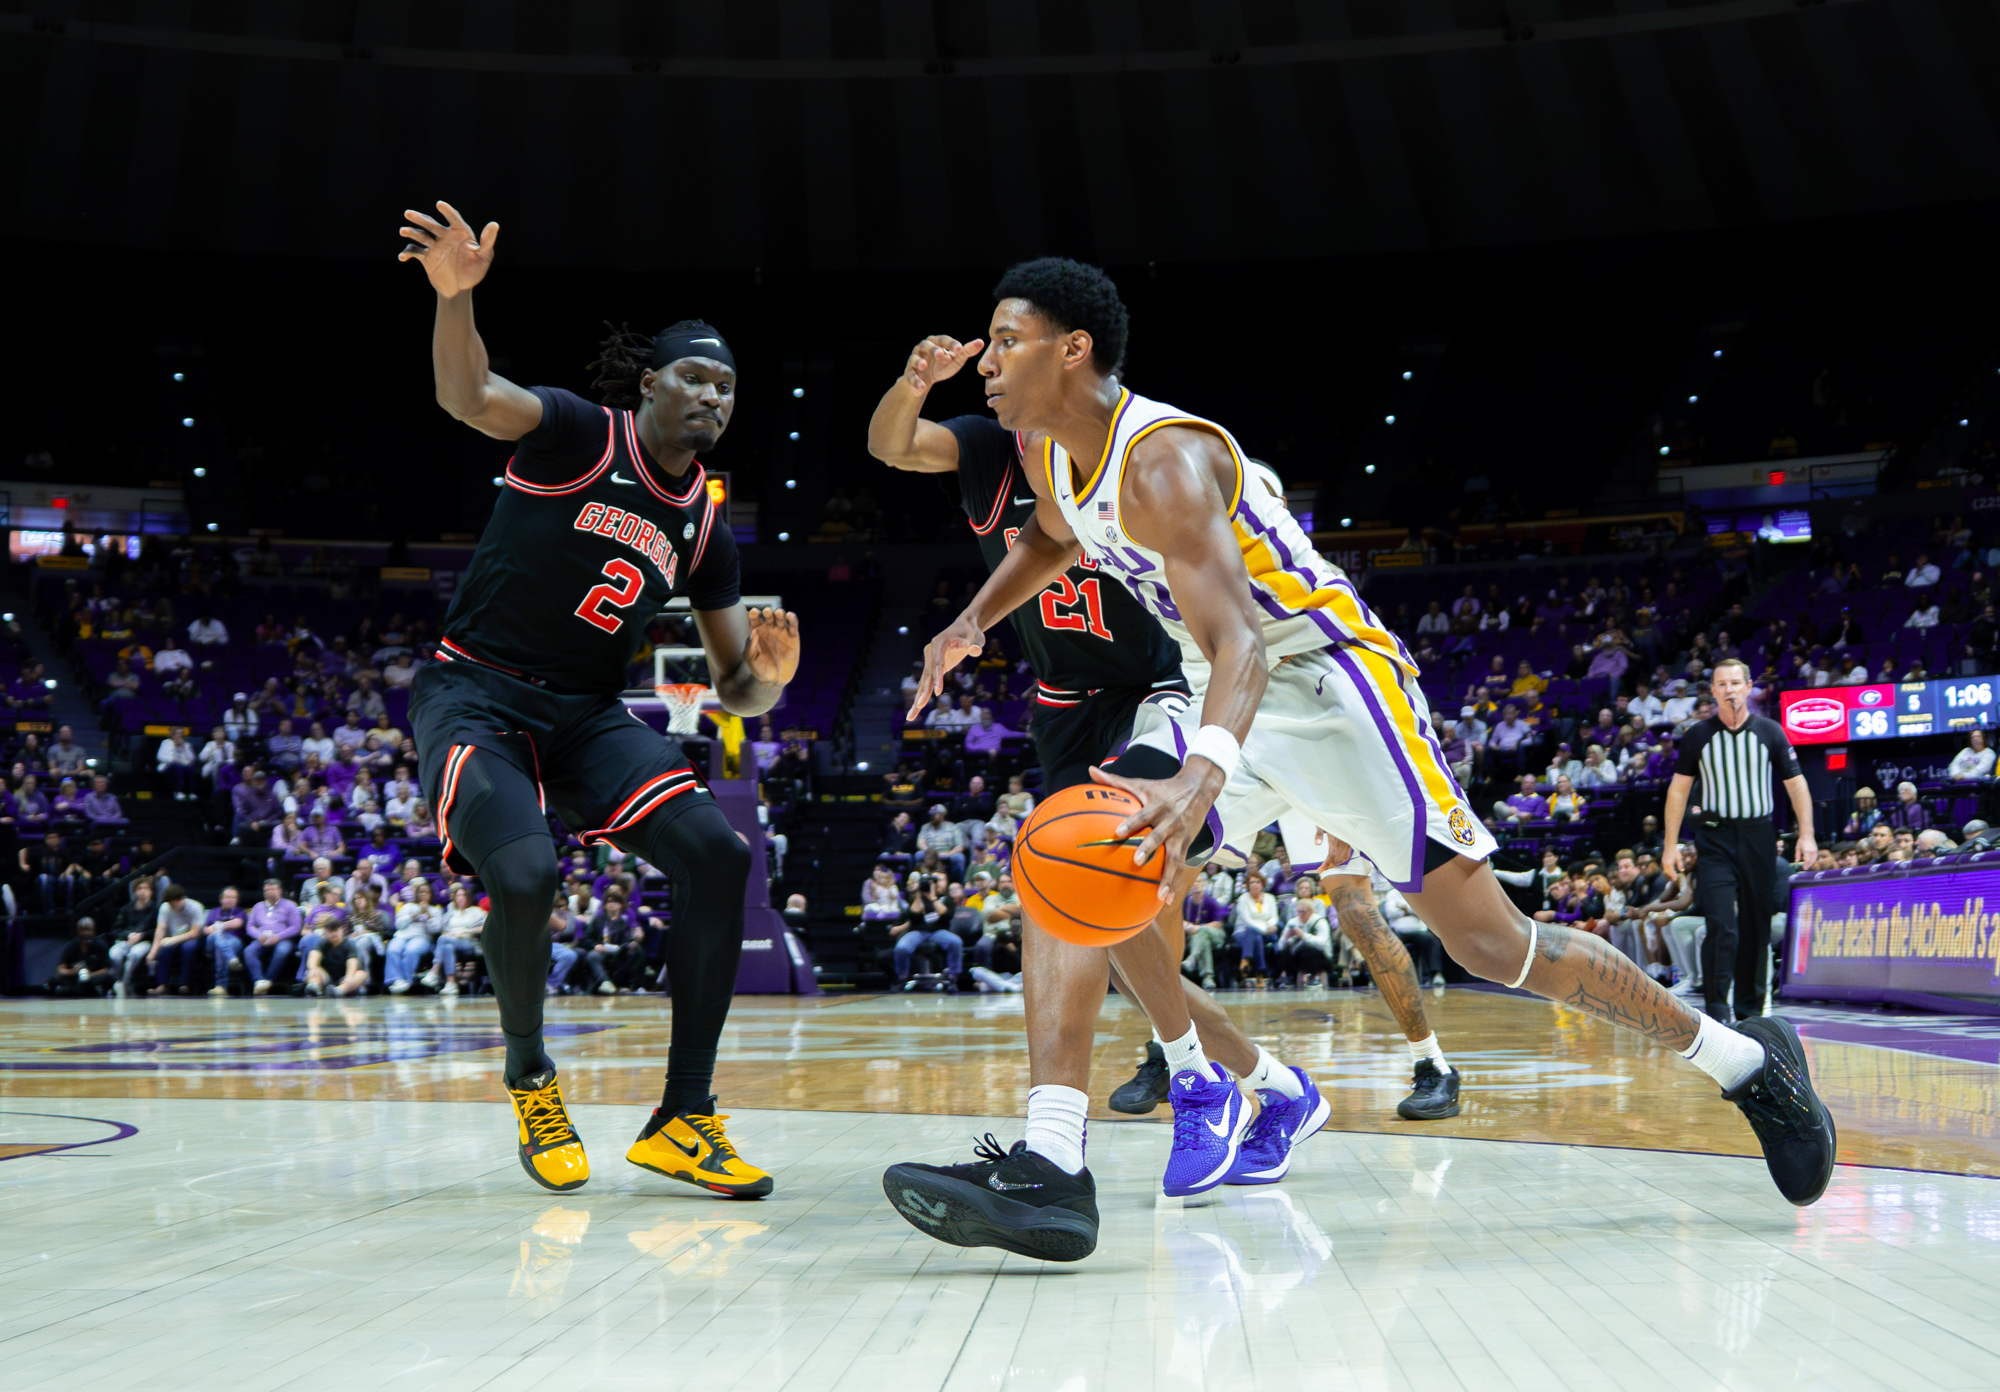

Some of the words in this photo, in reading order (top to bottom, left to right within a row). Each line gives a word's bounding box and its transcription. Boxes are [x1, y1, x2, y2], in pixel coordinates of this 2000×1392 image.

[1972, 496, 2000, 510] (22
[574, 501, 678, 590] GEORGIA
[574, 557, 645, 635] 2
[1038, 572, 1114, 642] 21
[1907, 693, 1921, 711] 5
[1944, 682, 1993, 708] 1:06
[1855, 710, 1889, 736] 36
[1813, 909, 1843, 957] Score
[1843, 904, 1875, 957] deals
[1874, 902, 1889, 957] in
[1889, 901, 1910, 957] the
[1909, 897, 1989, 959] McDonald's
